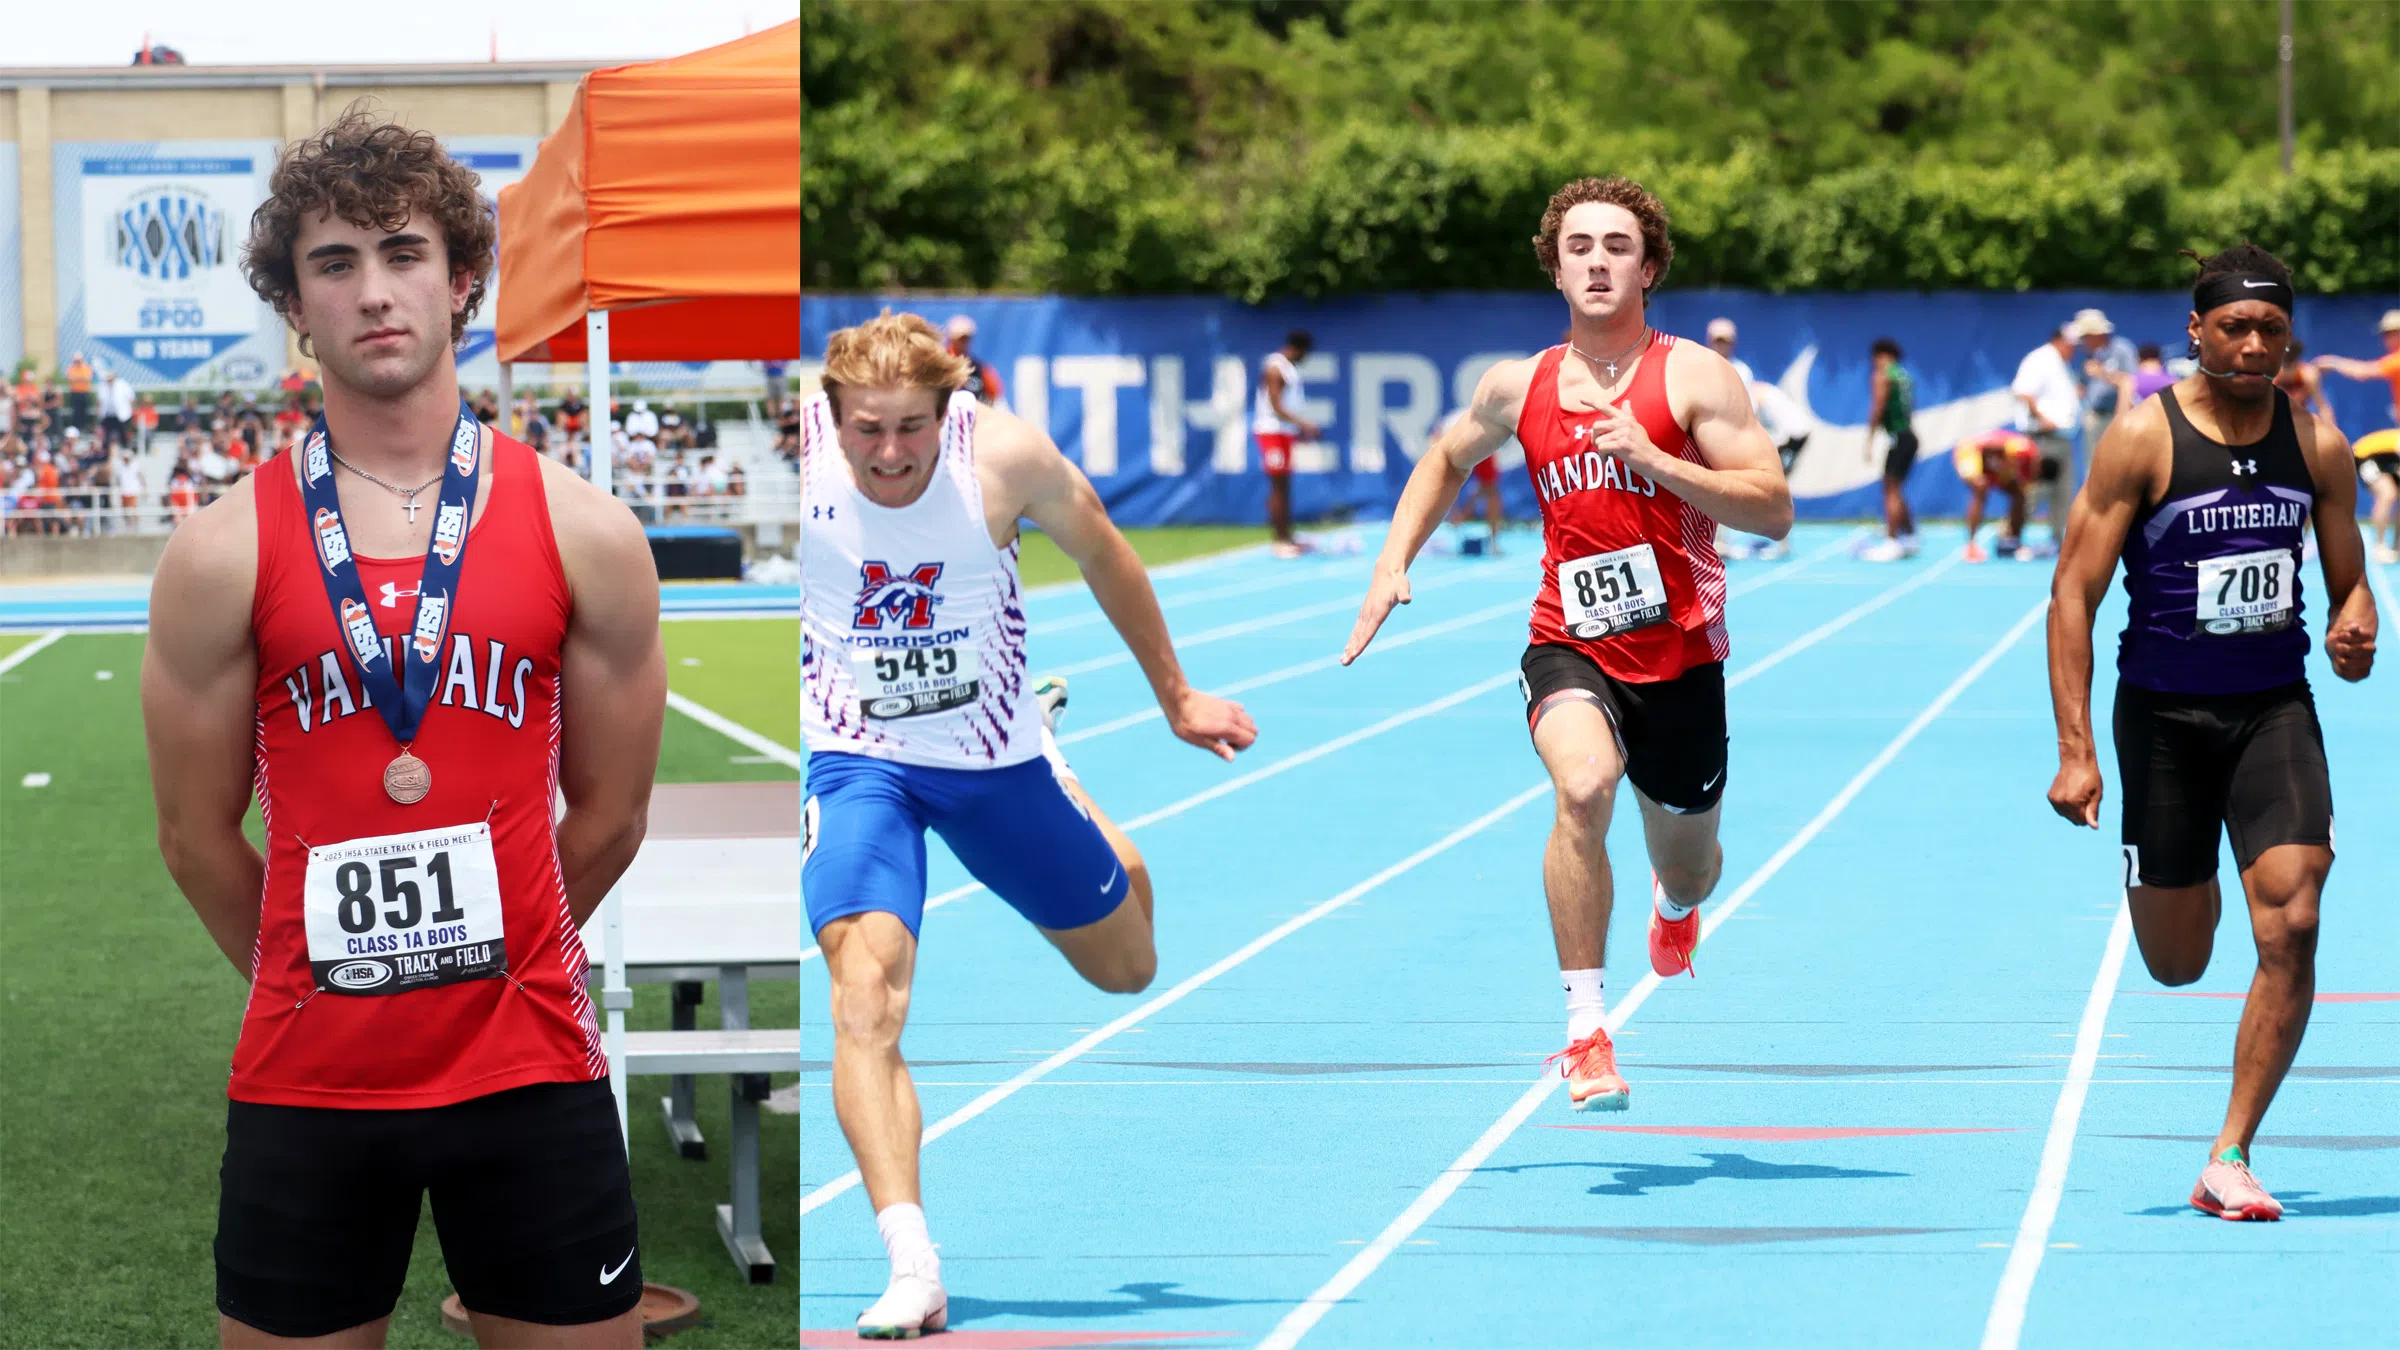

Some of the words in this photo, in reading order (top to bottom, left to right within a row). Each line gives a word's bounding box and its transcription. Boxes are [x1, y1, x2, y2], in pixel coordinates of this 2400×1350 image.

[1537, 451, 1657, 504] VANDALS
[433, 505, 464, 557] IHSA
[2187, 503, 2300, 534] LUTHERAN
[316, 511, 350, 569] IHSA
[1574, 561, 1643, 608] 851
[2217, 562, 2280, 606] 708
[1585, 605, 1610, 619] CLASS
[1613, 603, 1623, 612] 1A
[1624, 597, 1647, 610] BOYS
[1609, 612, 1633, 628] TRACK
[1640, 606, 1661, 620] FIELD
[2220, 606, 2246, 617] CLASS
[2249, 604, 2259, 614] 1A
[2260, 601, 2278, 612] BOYS
[2242, 615, 2265, 628] TRACK
[344, 602, 382, 665] IHSA
[413, 597, 445, 655] IHSA
[875, 647, 958, 682] 545
[284, 632, 534, 734] VAALS
[883, 682, 915, 695] CLASS
[918, 680, 930, 690] 1A
[933, 676, 957, 688] BOYS
[912, 692, 940, 706] TRACK
[950, 684, 971, 700] FIELD
[324, 851, 343, 861] 2025
[344, 849, 362, 858] IHSA
[364, 846, 388, 856] STATE
[391, 843, 416, 853] TRACK
[427, 838, 449, 848] FIELD
[452, 835, 472, 845] MEET
[336, 851, 465, 934] 851
[347, 934, 398, 955] CLASS
[403, 931, 424, 949] 1A
[427, 925, 468, 946] BOYS
[395, 952, 439, 976] TRACK
[440, 956, 453, 965] AND
[456, 944, 491, 967] FIELD
